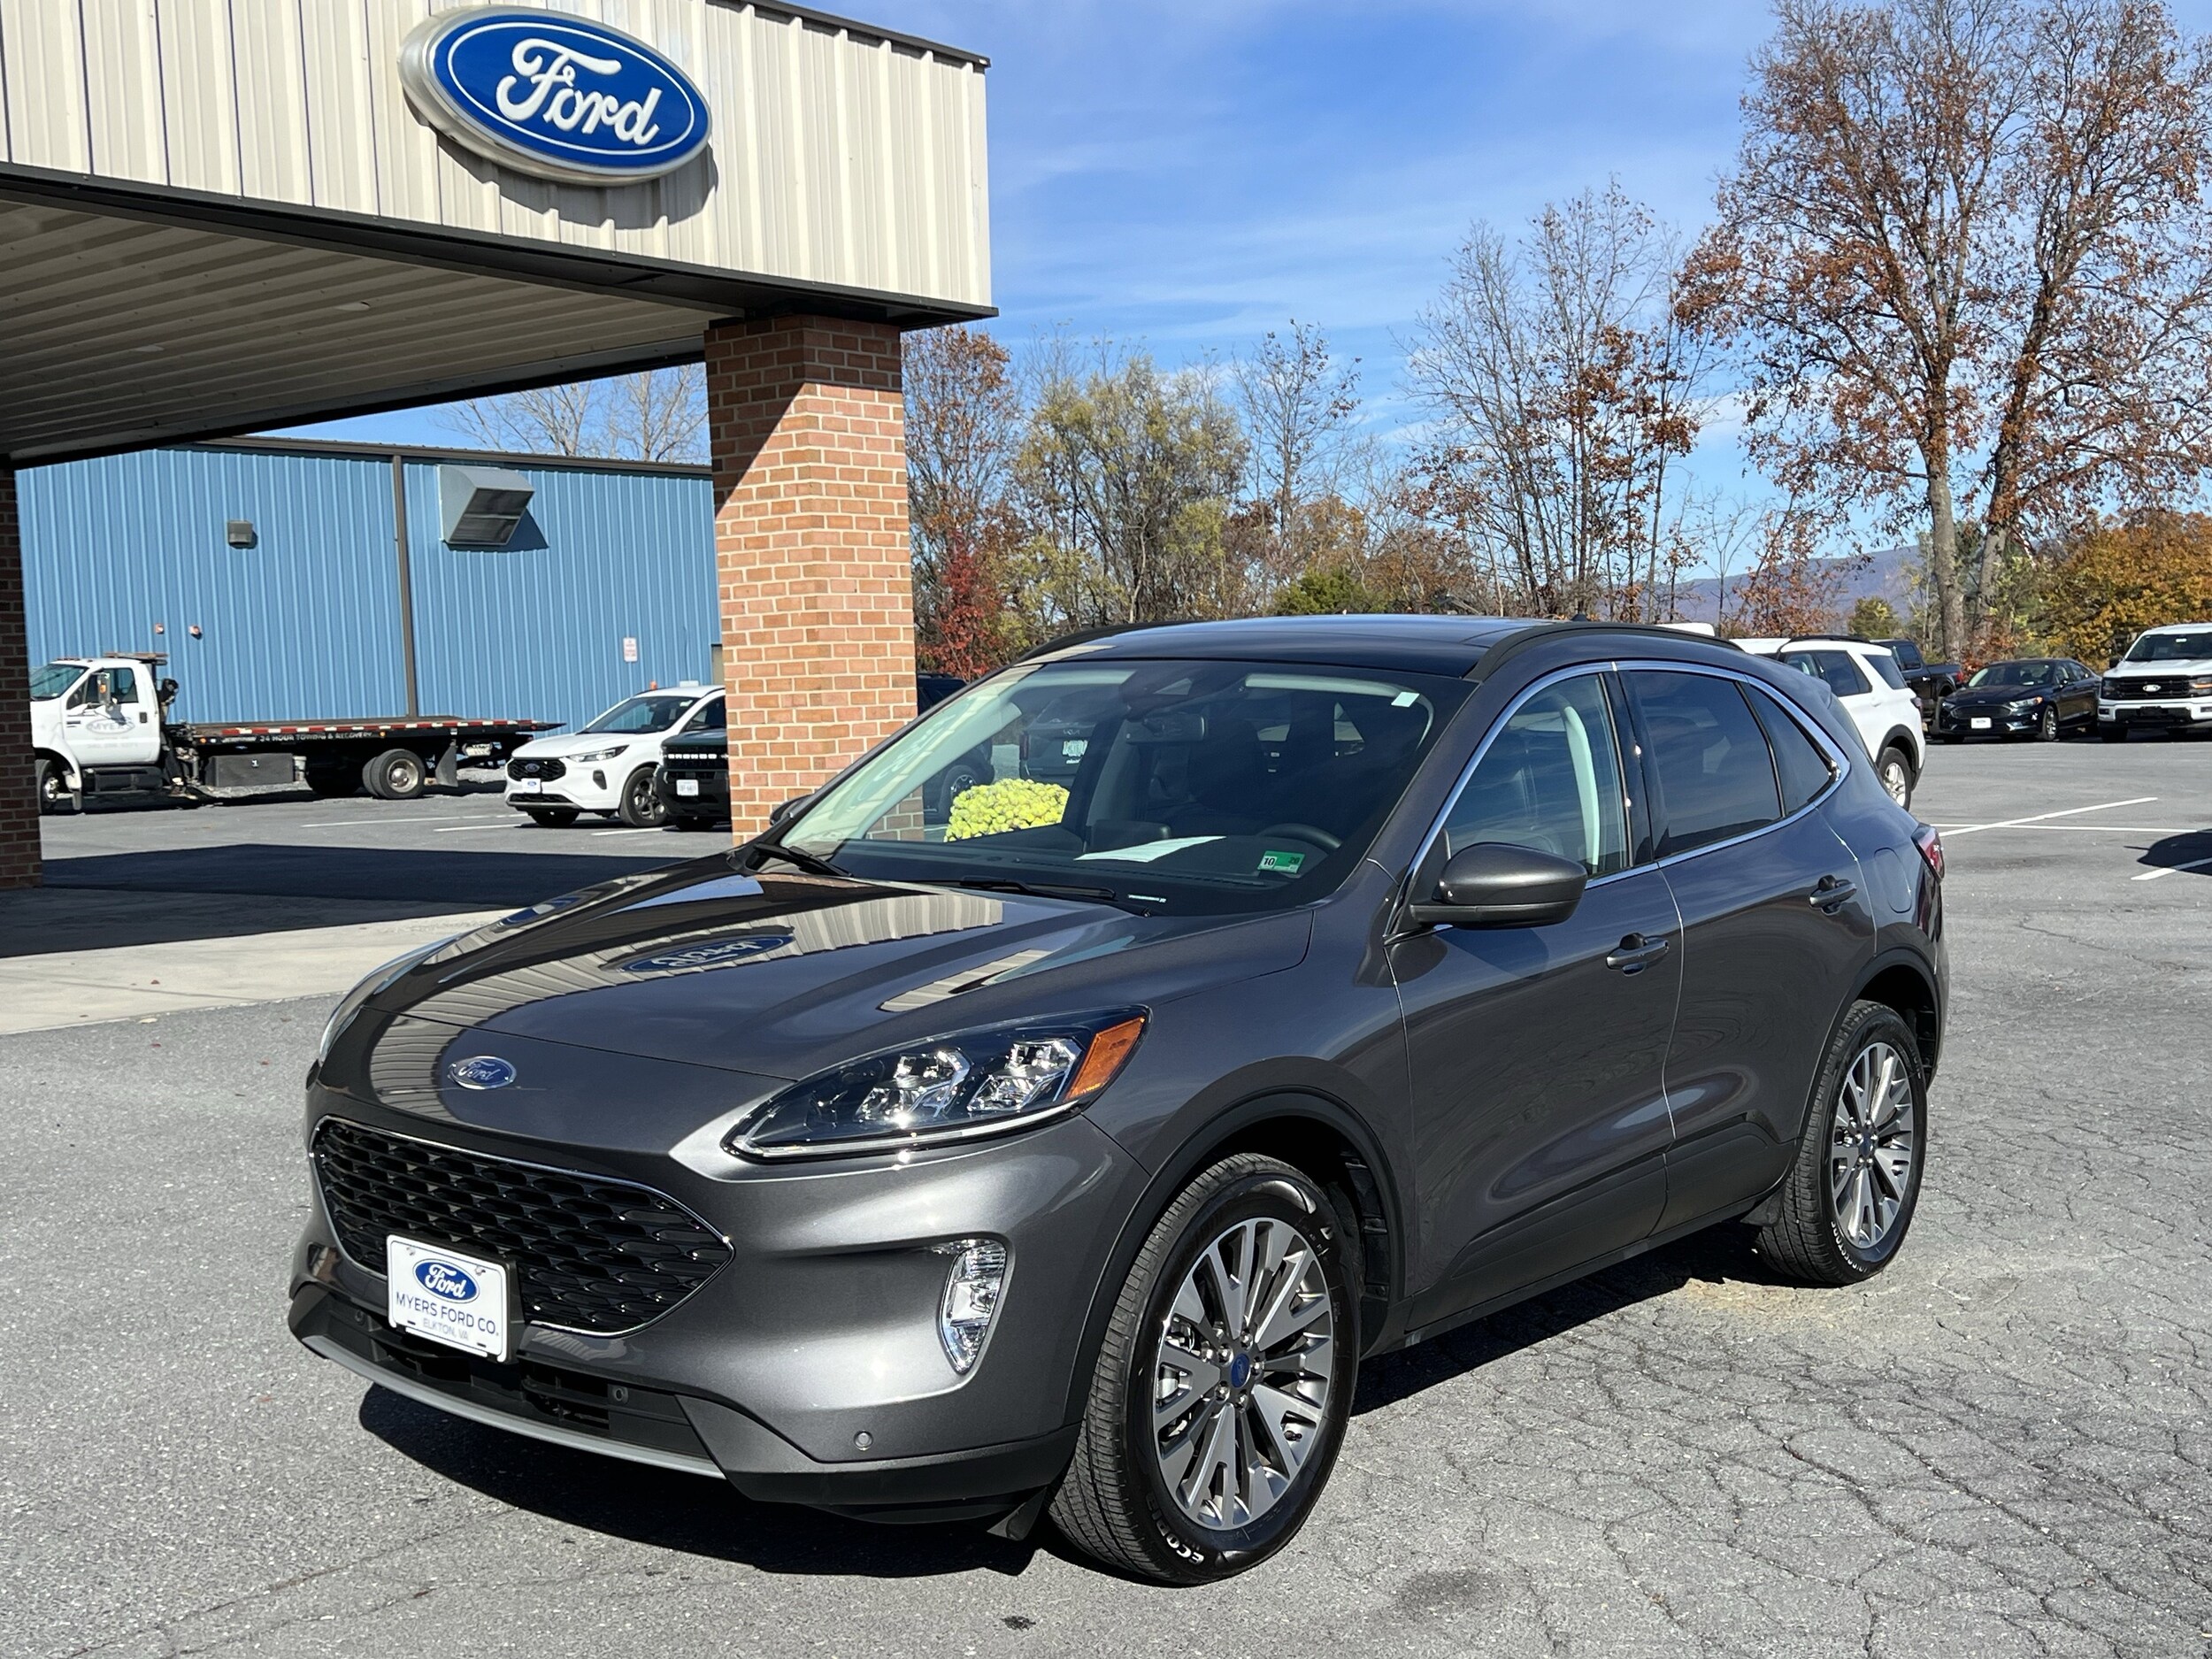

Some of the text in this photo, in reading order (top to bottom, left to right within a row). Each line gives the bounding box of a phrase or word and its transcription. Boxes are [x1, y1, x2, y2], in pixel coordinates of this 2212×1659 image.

[495, 37, 664, 146] Ford
[1263, 856, 1276, 866] 10
[457, 1059, 502, 1081] Ford
[425, 1263, 468, 1299] Ford
[396, 1291, 500, 1337] MYERS FORD CO.
[422, 1317, 469, 1340] ELKTON, VA
